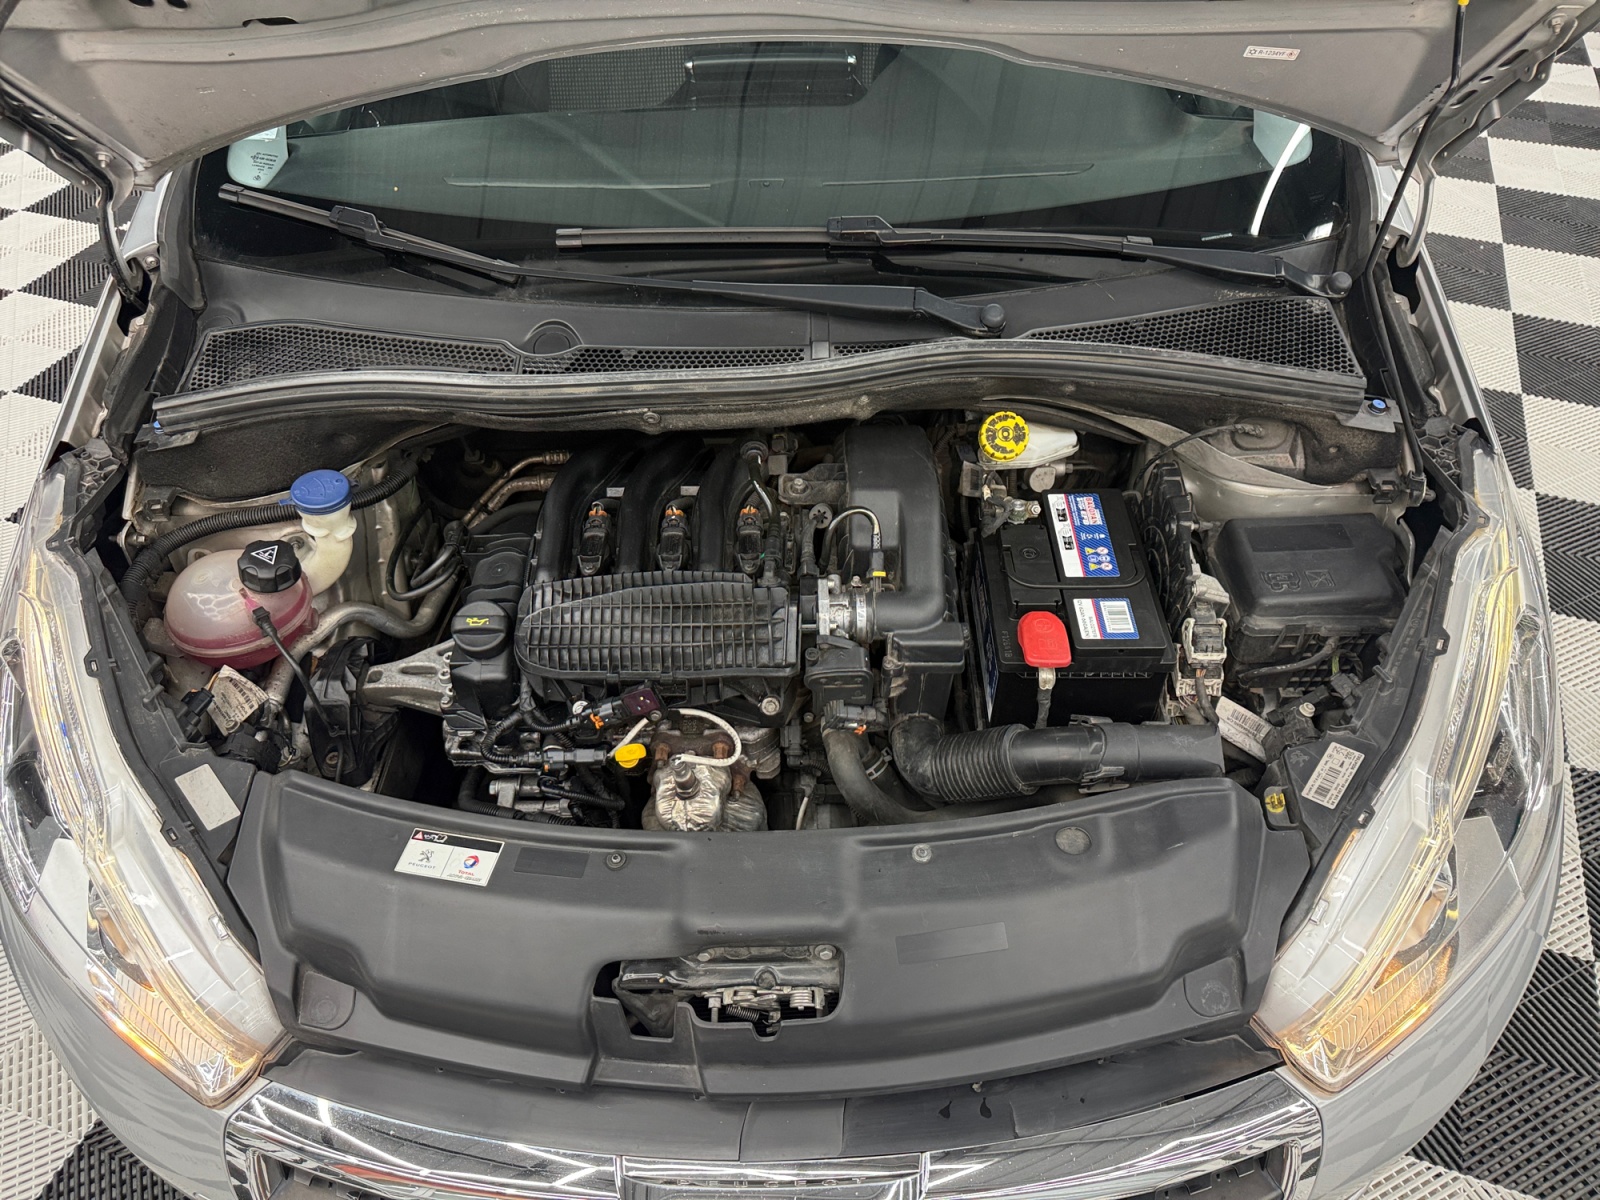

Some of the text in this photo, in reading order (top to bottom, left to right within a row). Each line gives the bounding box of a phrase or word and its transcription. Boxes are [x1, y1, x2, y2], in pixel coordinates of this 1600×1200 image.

[408, 861, 437, 870] PEUGEOT
[457, 869, 475, 877] TOTAL
[677, 1177, 867, 1188] PEUGEOT
